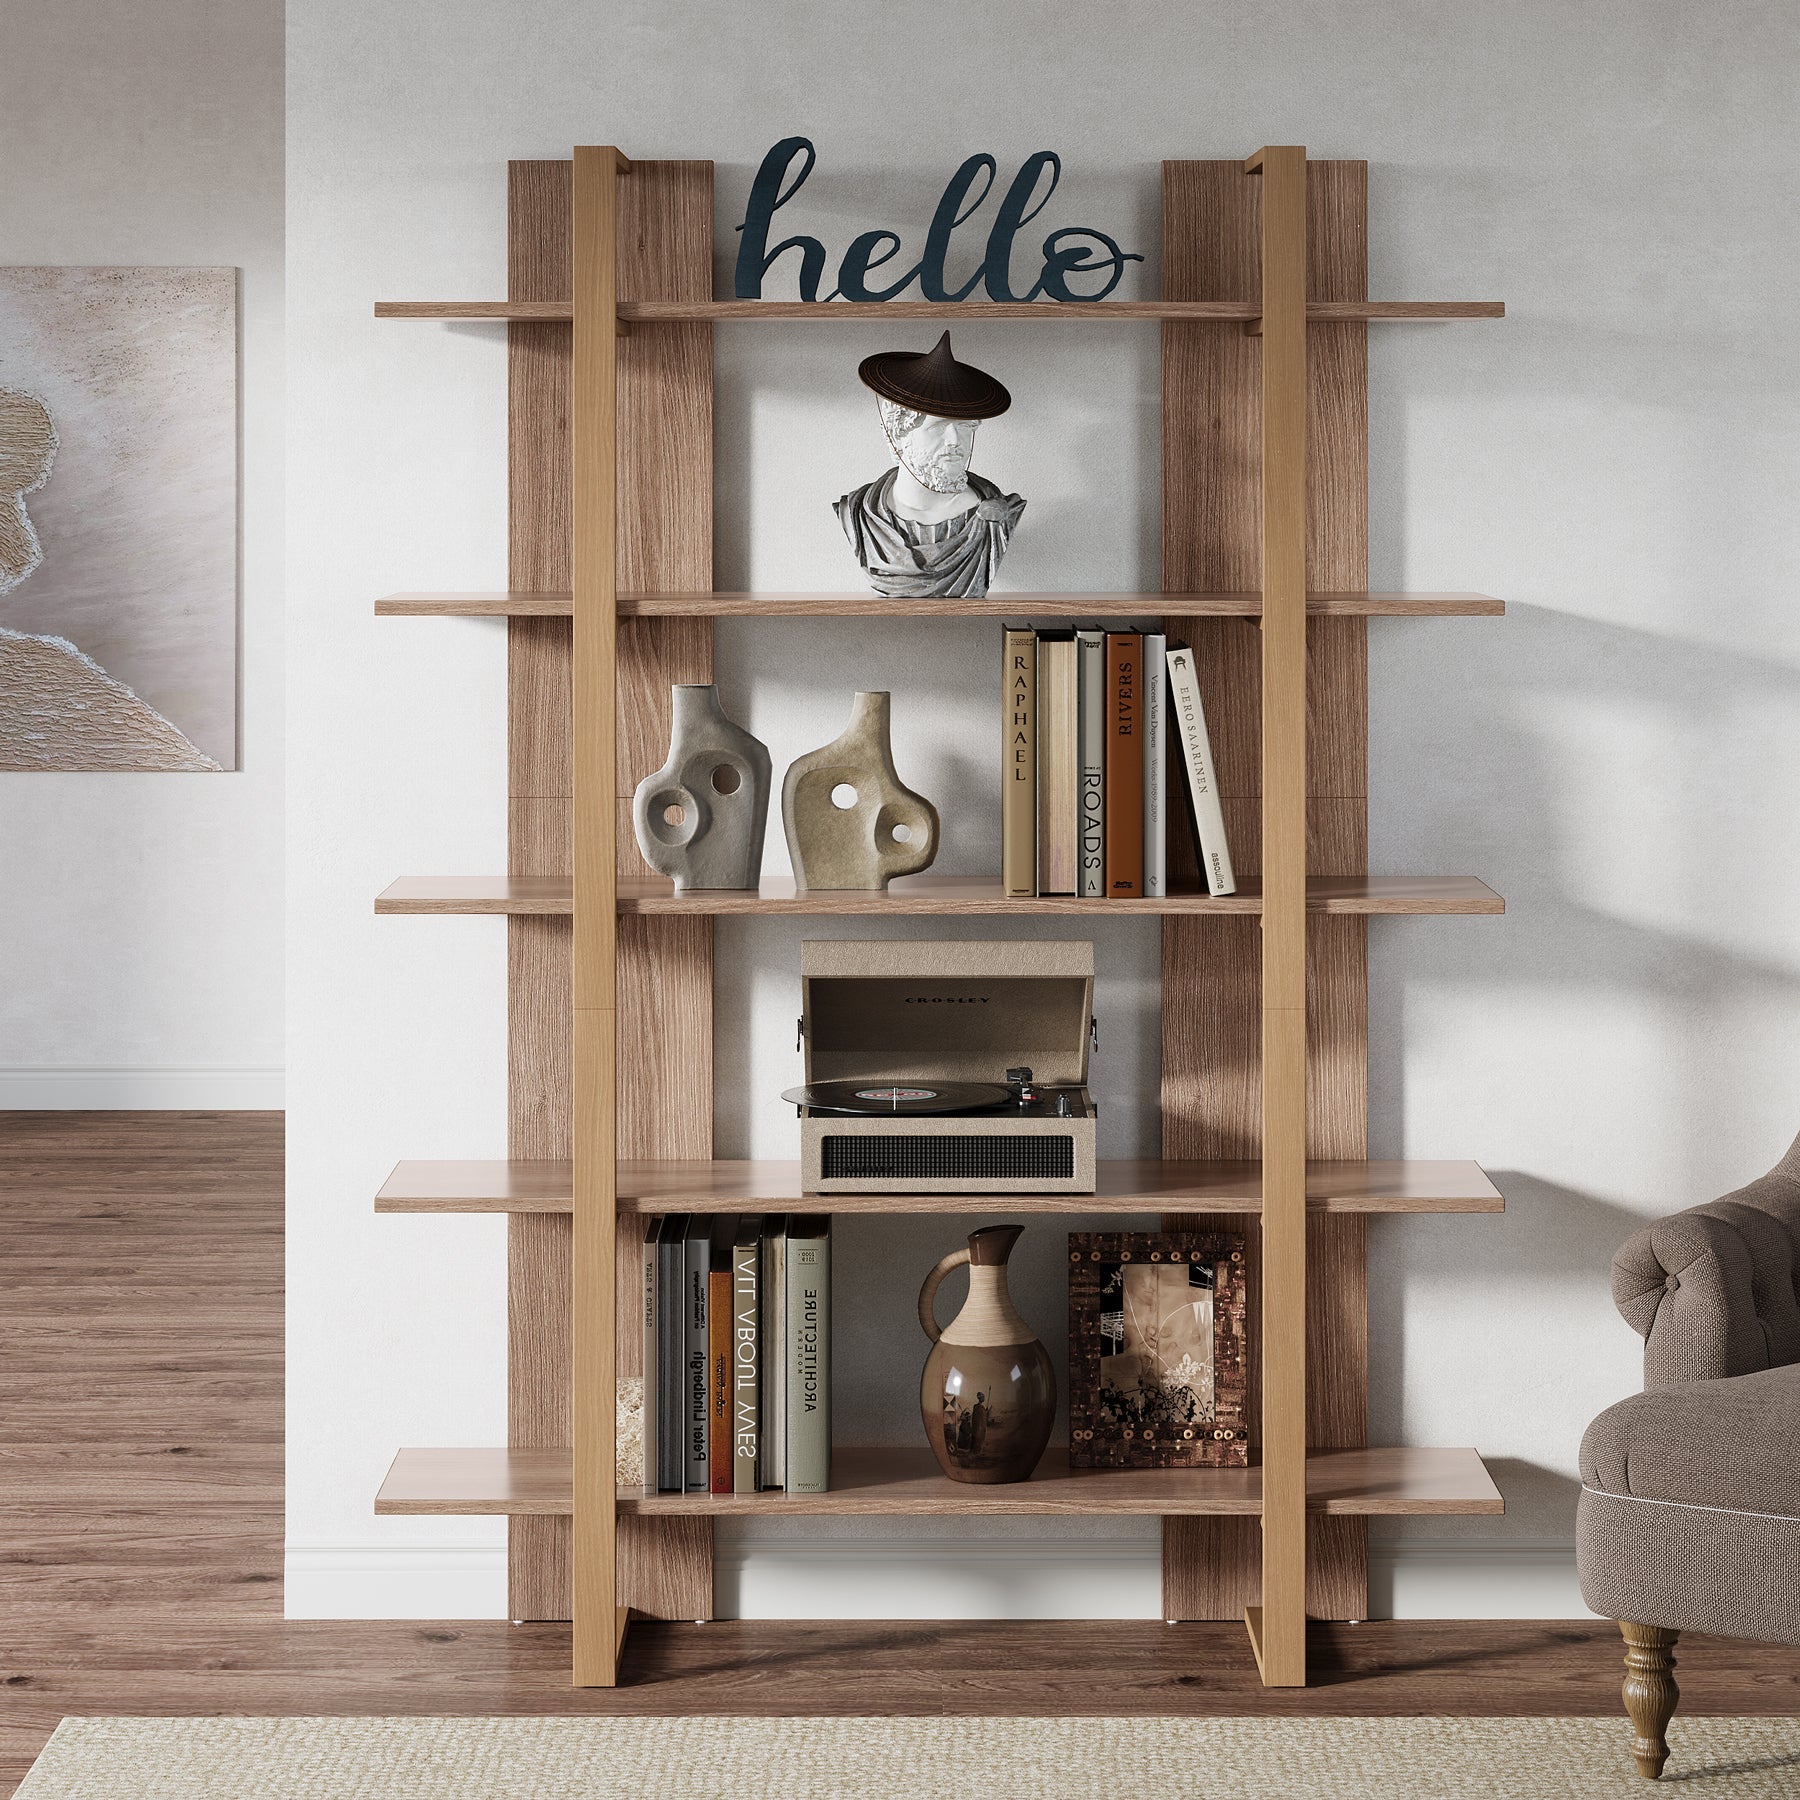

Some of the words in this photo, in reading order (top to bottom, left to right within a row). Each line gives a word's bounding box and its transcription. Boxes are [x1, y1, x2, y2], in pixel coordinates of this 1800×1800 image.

[735, 136, 1144, 302] hello
[1014, 656, 1029, 781] RAPHAEL
[1118, 662, 1133, 736] RIVERS
[1151, 674, 1159, 702] Vincent
[1151, 704, 1159, 720] Van
[1149, 720, 1159, 748] Duysen
[1180, 687, 1194, 721] EERO
[1187, 725, 1208, 795] SAARINEN
[1083, 773, 1101, 870] ROADS
[1211, 852, 1224, 890] assouline
